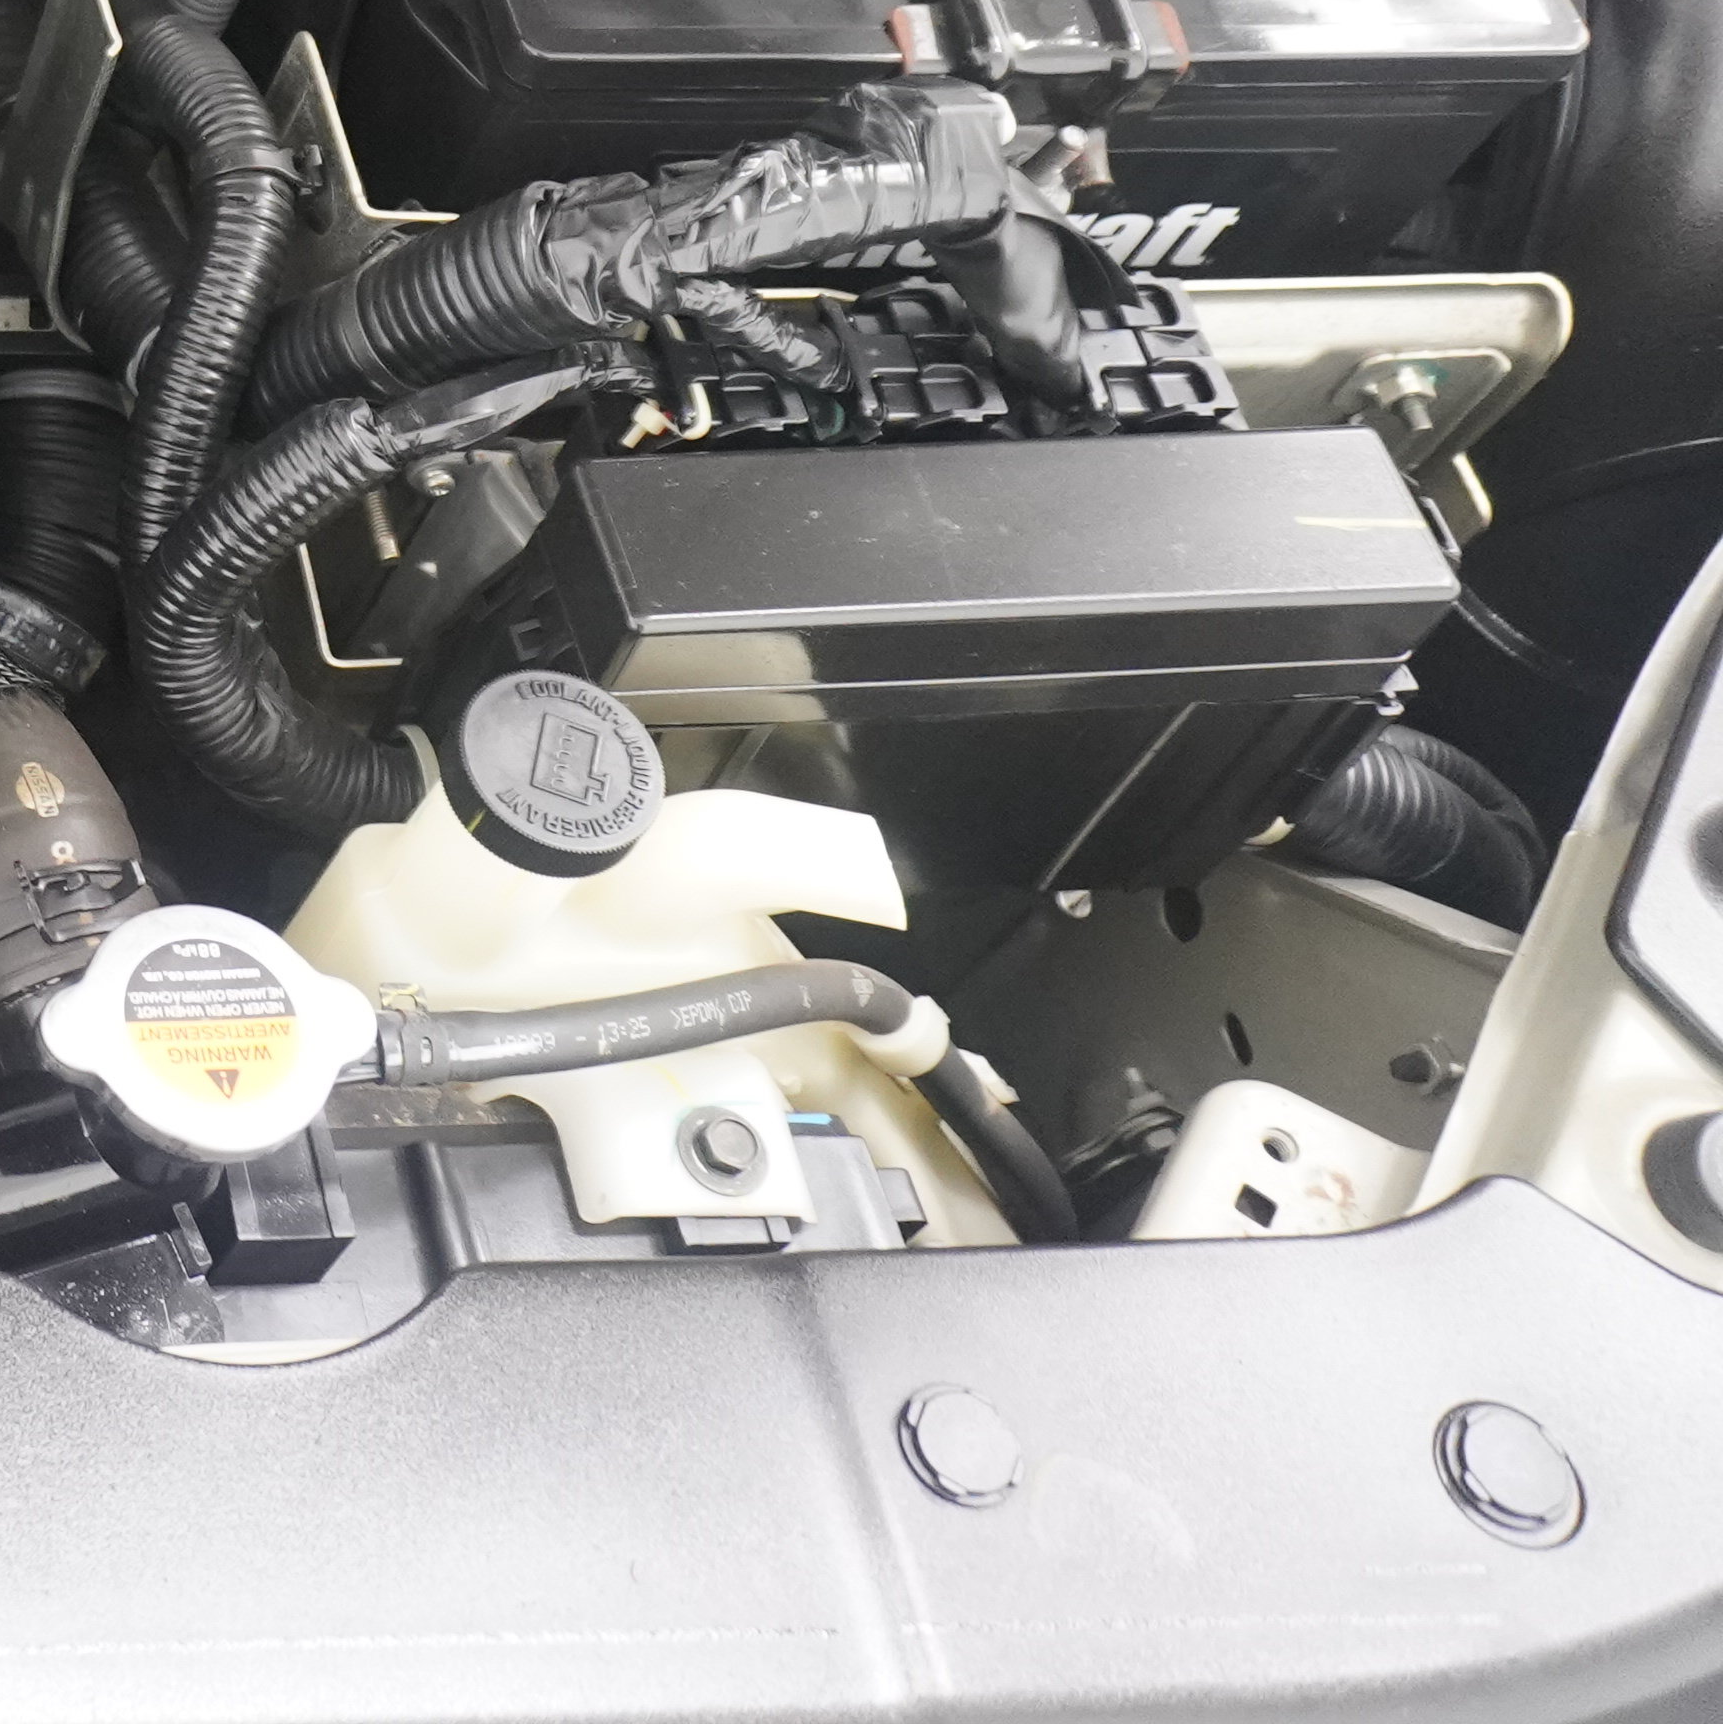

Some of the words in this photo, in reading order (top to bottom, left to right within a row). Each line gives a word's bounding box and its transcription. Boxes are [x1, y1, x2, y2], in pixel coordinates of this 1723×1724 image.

[24, 765, 56, 815] NISSAN
[184, 969, 222, 982] MOTOR
[221, 967, 262, 981] NISSAN
[128, 991, 174, 1005] CHAUD.
[180, 989, 227, 1003] OUVRIR
[226, 987, 266, 1001] JAMAIS
[266, 986, 285, 1000] NE
[133, 1005, 164, 1019] HOT.
[163, 1004, 205, 1018] WHEN
[205, 1003, 242, 1017] OPEN
[241, 1001, 286, 1016] NEVER
[137, 1023, 291, 1042] AVERTISSEMENT
[166, 1045, 272, 1064] WARNING
